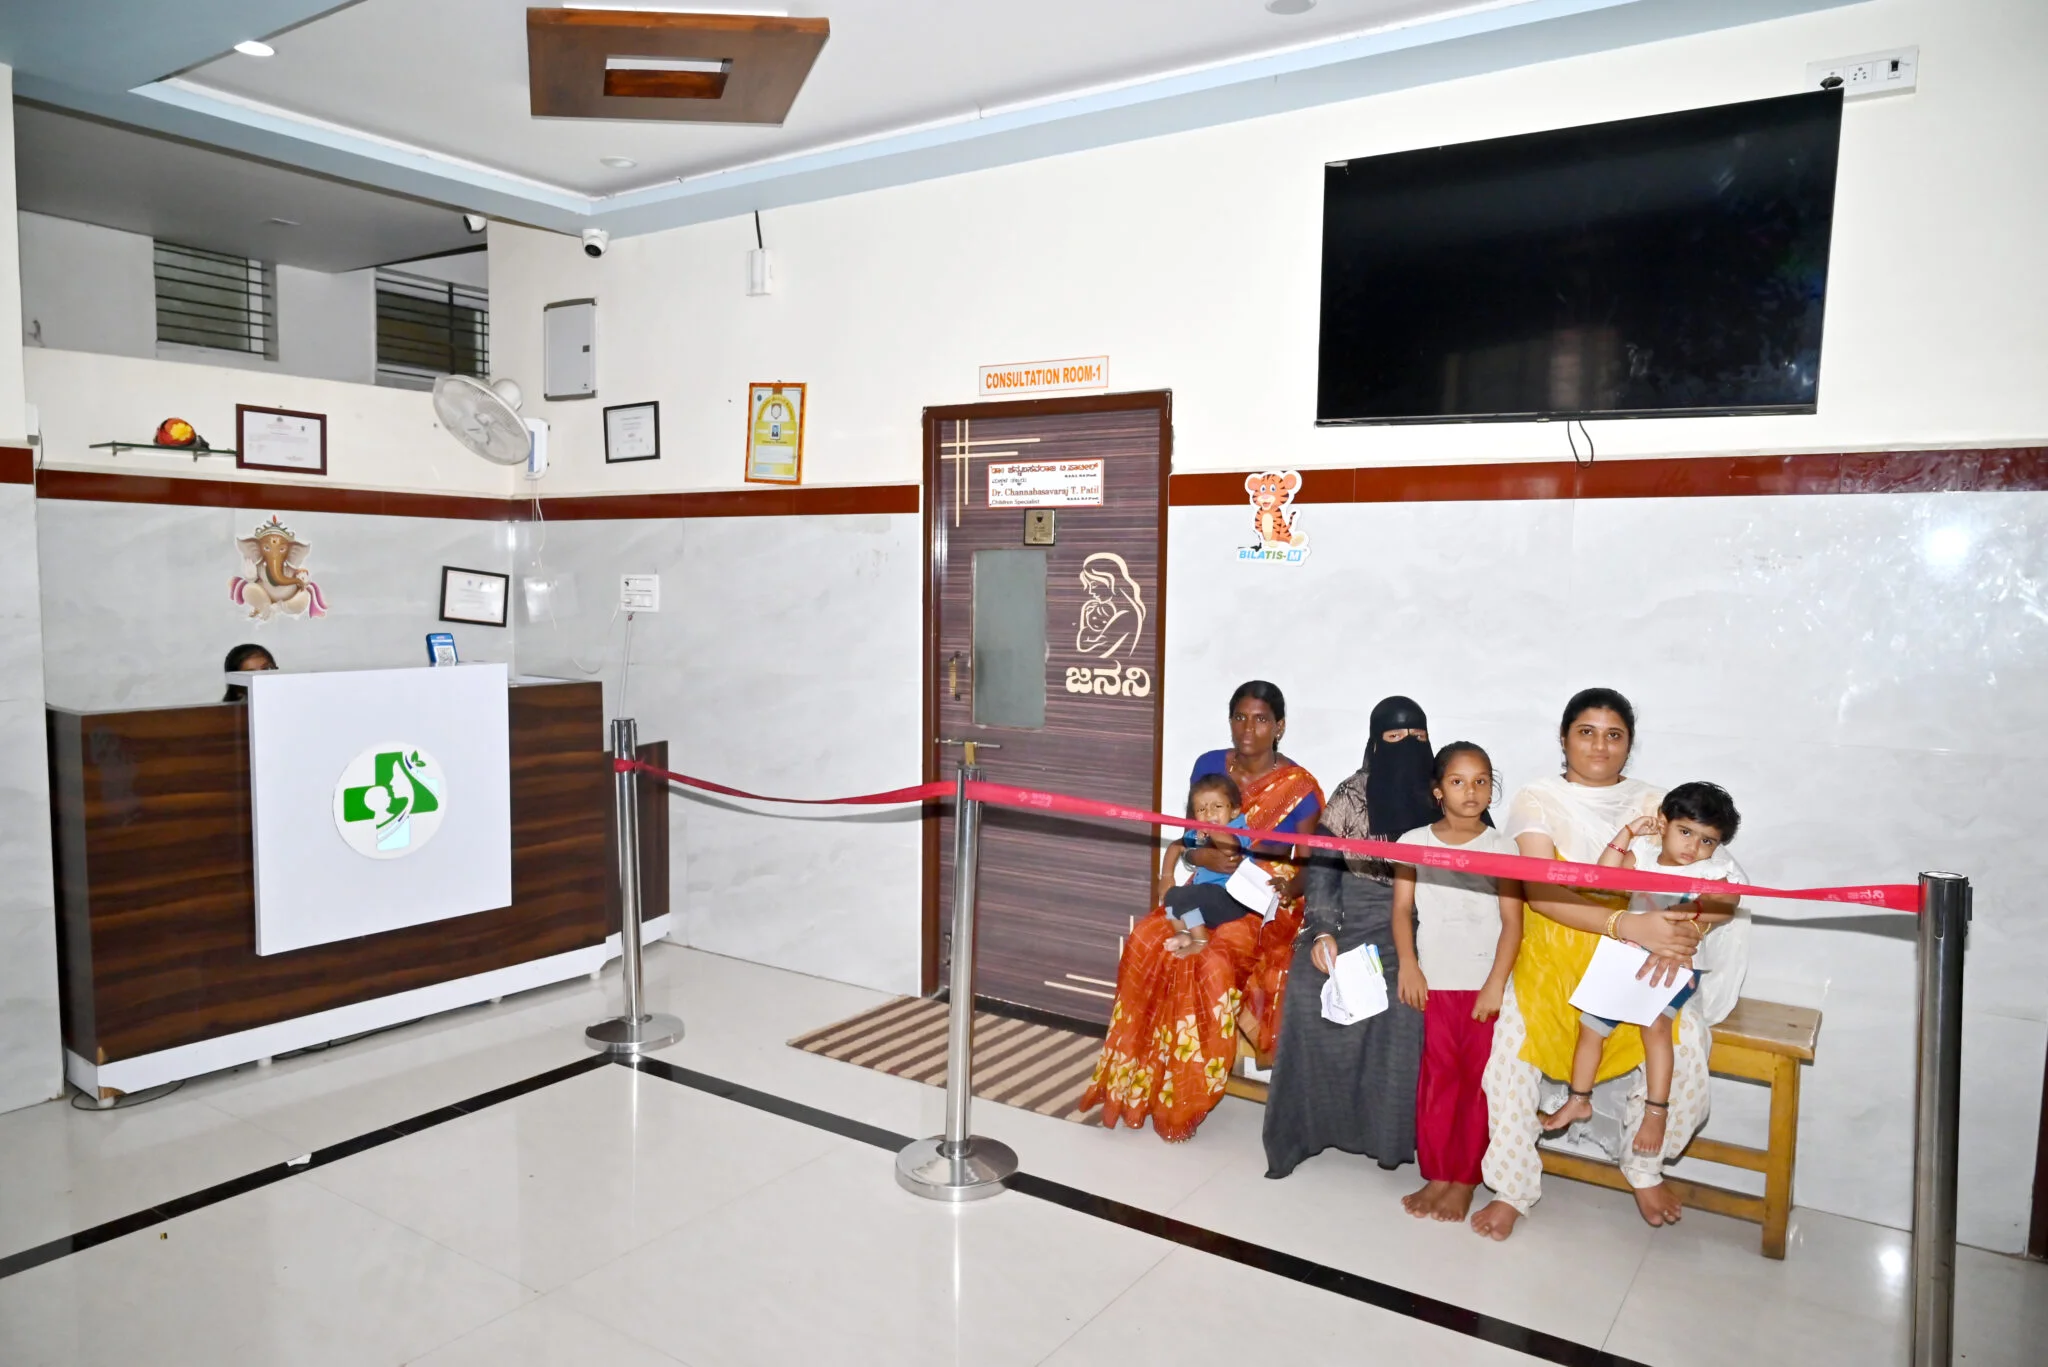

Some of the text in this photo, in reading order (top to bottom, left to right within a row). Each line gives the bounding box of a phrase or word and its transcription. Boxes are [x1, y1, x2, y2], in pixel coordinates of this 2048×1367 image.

[986, 364, 1101, 389] CONSULTATION ROOM-1
[992, 488, 1003, 497] Dr.
[1080, 485, 1099, 494] Patil
[1239, 549, 1302, 561] BILATIS-M
[1065, 659, 1151, 697] ಜನನಿ
